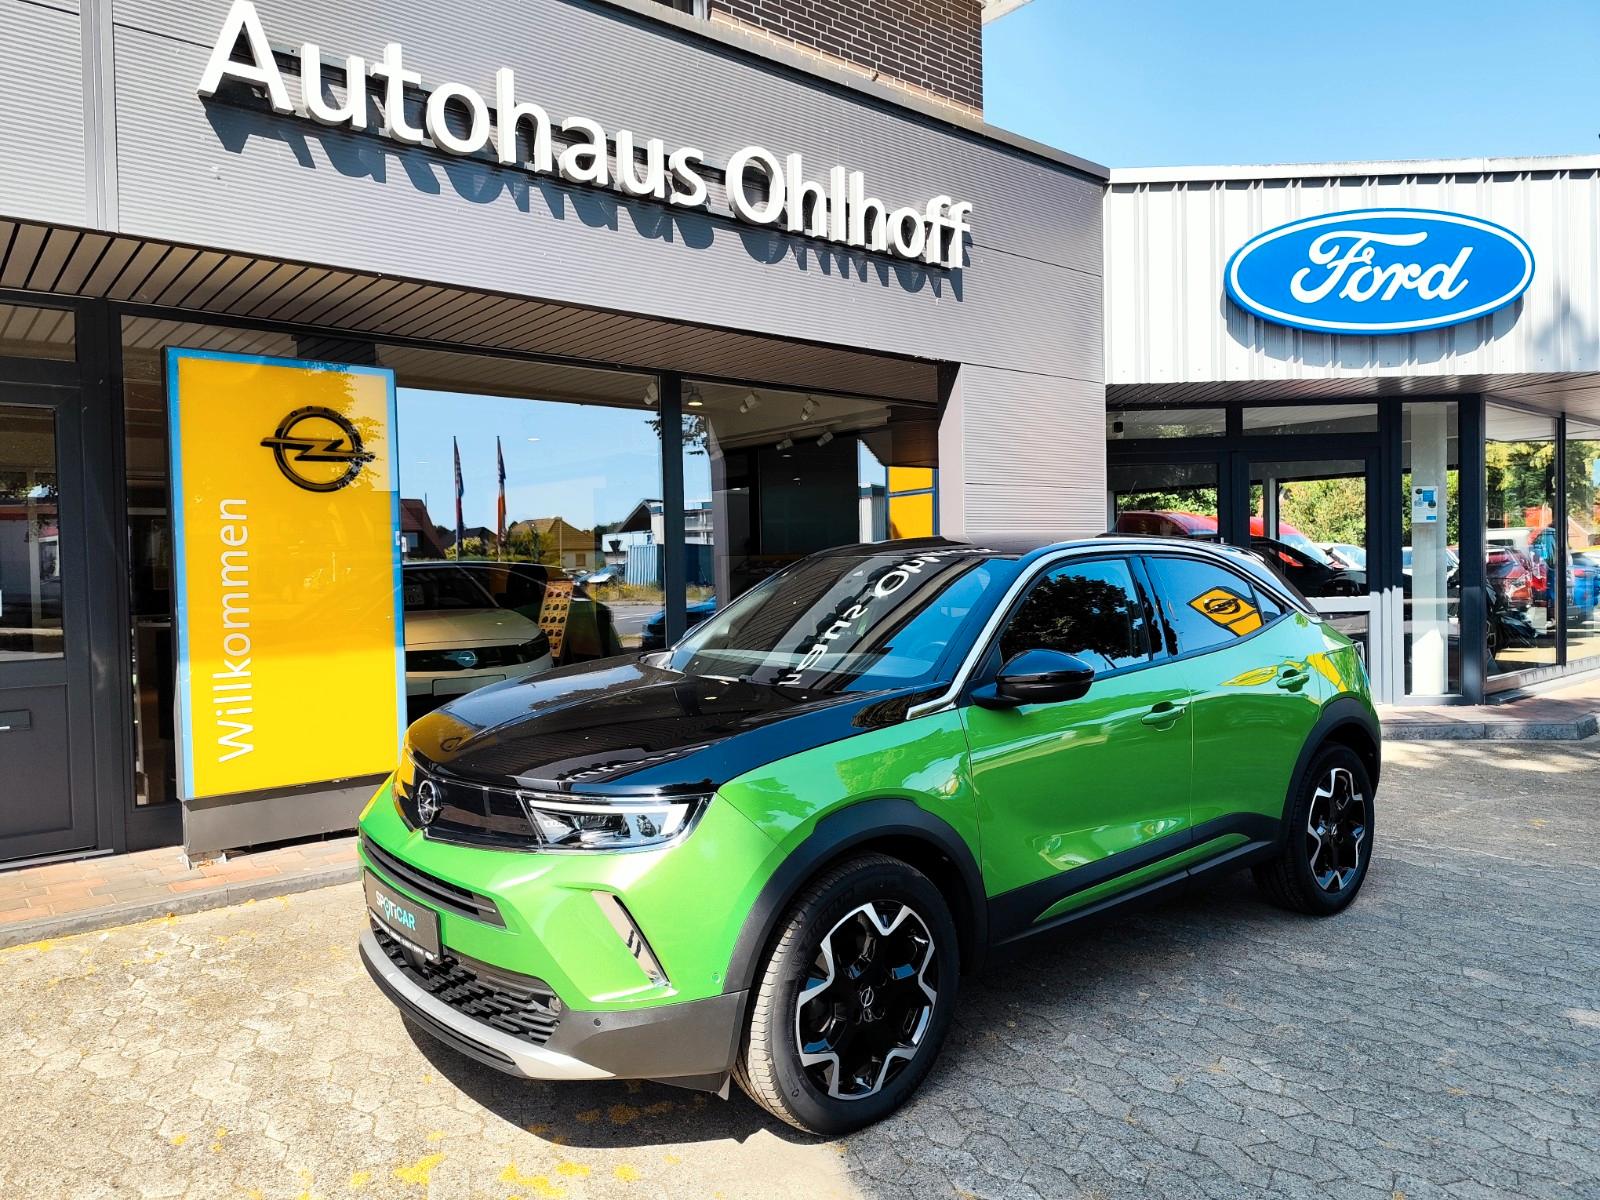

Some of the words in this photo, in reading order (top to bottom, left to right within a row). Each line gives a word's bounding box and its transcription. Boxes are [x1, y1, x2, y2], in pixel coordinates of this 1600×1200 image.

[197, 0, 708, 207] Autohaus
[725, 145, 973, 269] Ohlhoff
[1290, 230, 1474, 303] Ford
[212, 498, 254, 763] Willkommen
